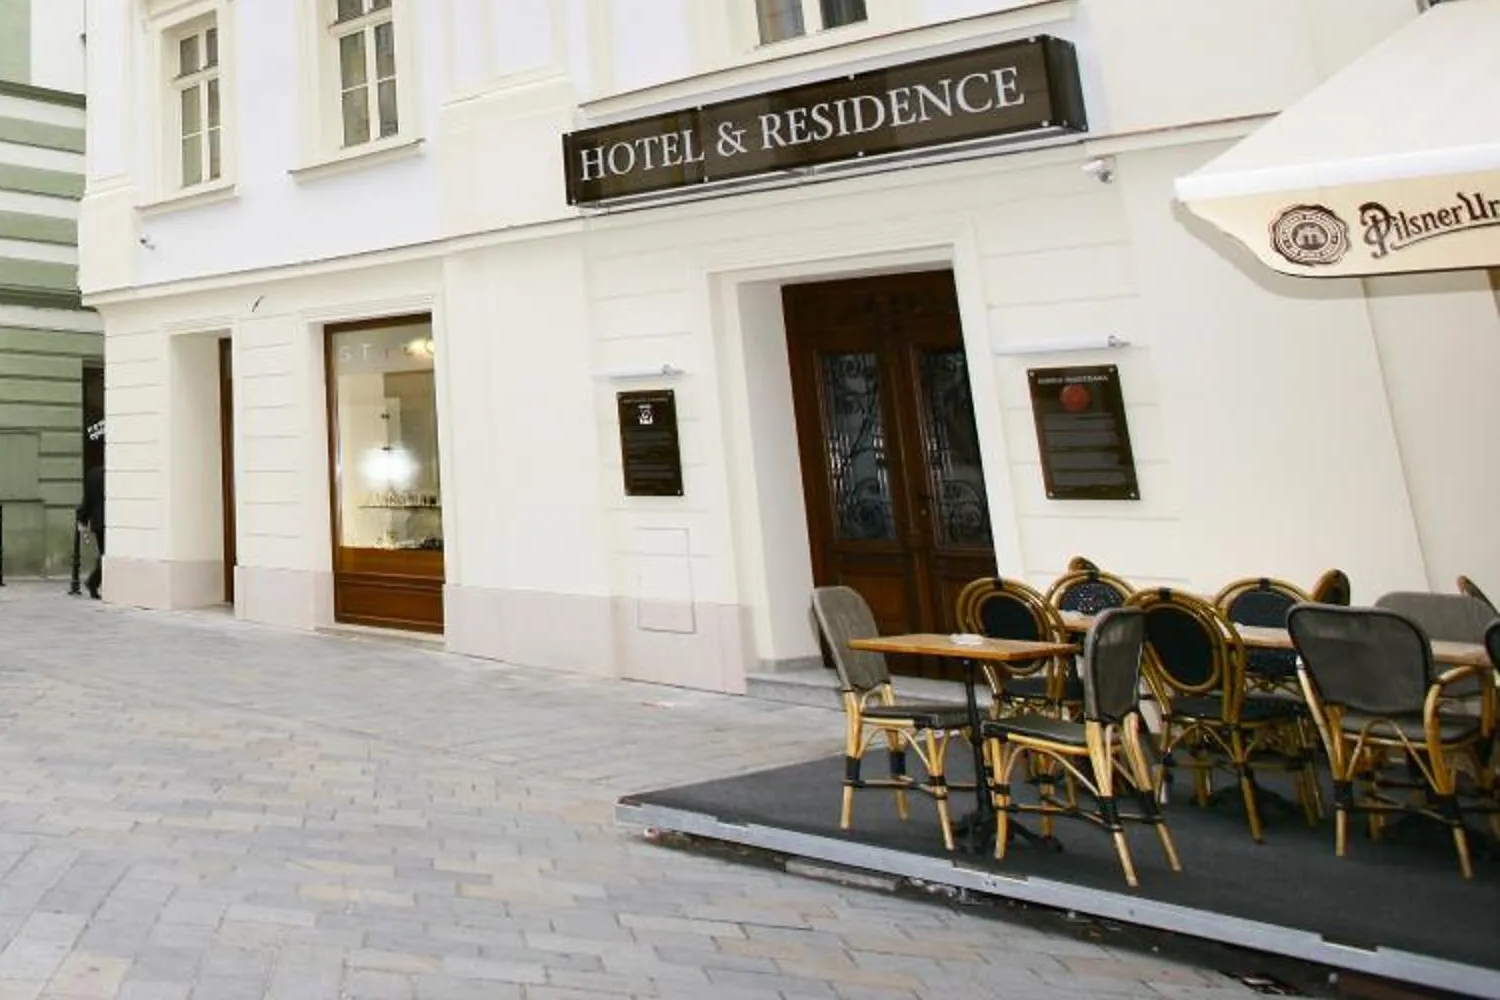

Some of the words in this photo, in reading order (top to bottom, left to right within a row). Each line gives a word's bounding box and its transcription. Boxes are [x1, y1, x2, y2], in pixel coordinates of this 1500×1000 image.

[580, 128, 706, 182] HOTEL
[716, 120, 749, 158] &
[758, 66, 1027, 151] RESIDENCE
[1358, 200, 1464, 259] Pilsner
